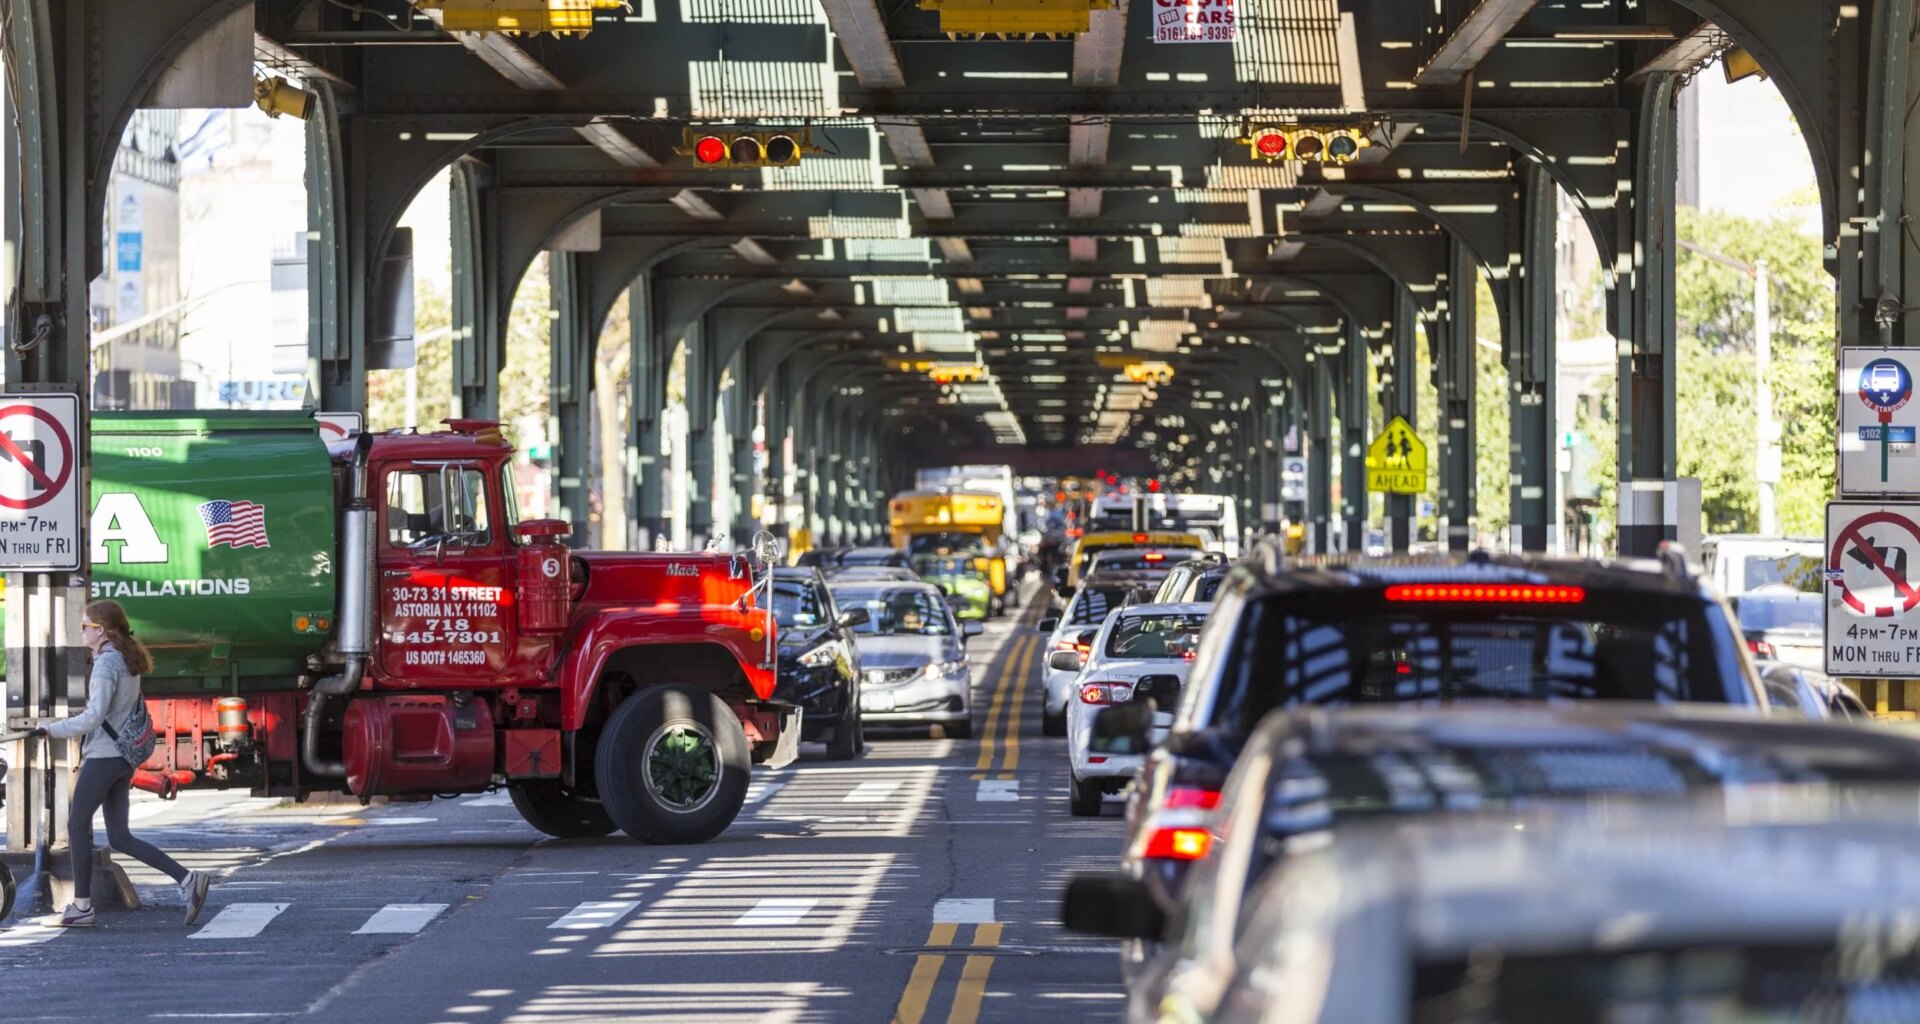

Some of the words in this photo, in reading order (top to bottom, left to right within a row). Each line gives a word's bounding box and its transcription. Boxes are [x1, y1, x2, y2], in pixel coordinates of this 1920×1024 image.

[1160, 11, 1178, 24] FOR
[1864, 398, 1873, 408] NO
[1875, 398, 1907, 413] STANDING
[125, 447, 163, 457] 1100
[1375, 475, 1419, 488] AHEAD
[0, 516, 57, 532] PM-7PM
[91, 492, 169, 564] A
[12, 543, 40, 554] THRU
[46, 538, 70, 554] FRI
[547, 560, 556, 575] 5
[666, 563, 699, 576] Mack
[91, 578, 250, 598] STALLATIONS
[393, 587, 428, 601] 30-73
[432, 587, 446, 601] 31
[451, 587, 502, 601] STREET
[395, 603, 441, 617] ASTORIA
[444, 603, 463, 617] N.Y.
[466, 603, 497, 617] 11102
[426, 619, 469, 631] 718
[1847, 623, 1918, 640] 4PM-7PM
[392, 632, 500, 644] 545-7301
[406, 651, 419, 665] US
[421, 651, 445, 665] DOT#
[448, 651, 485, 665] 1465360
[1832, 645, 1866, 662] MON
[1872, 651, 1900, 662] THRU
